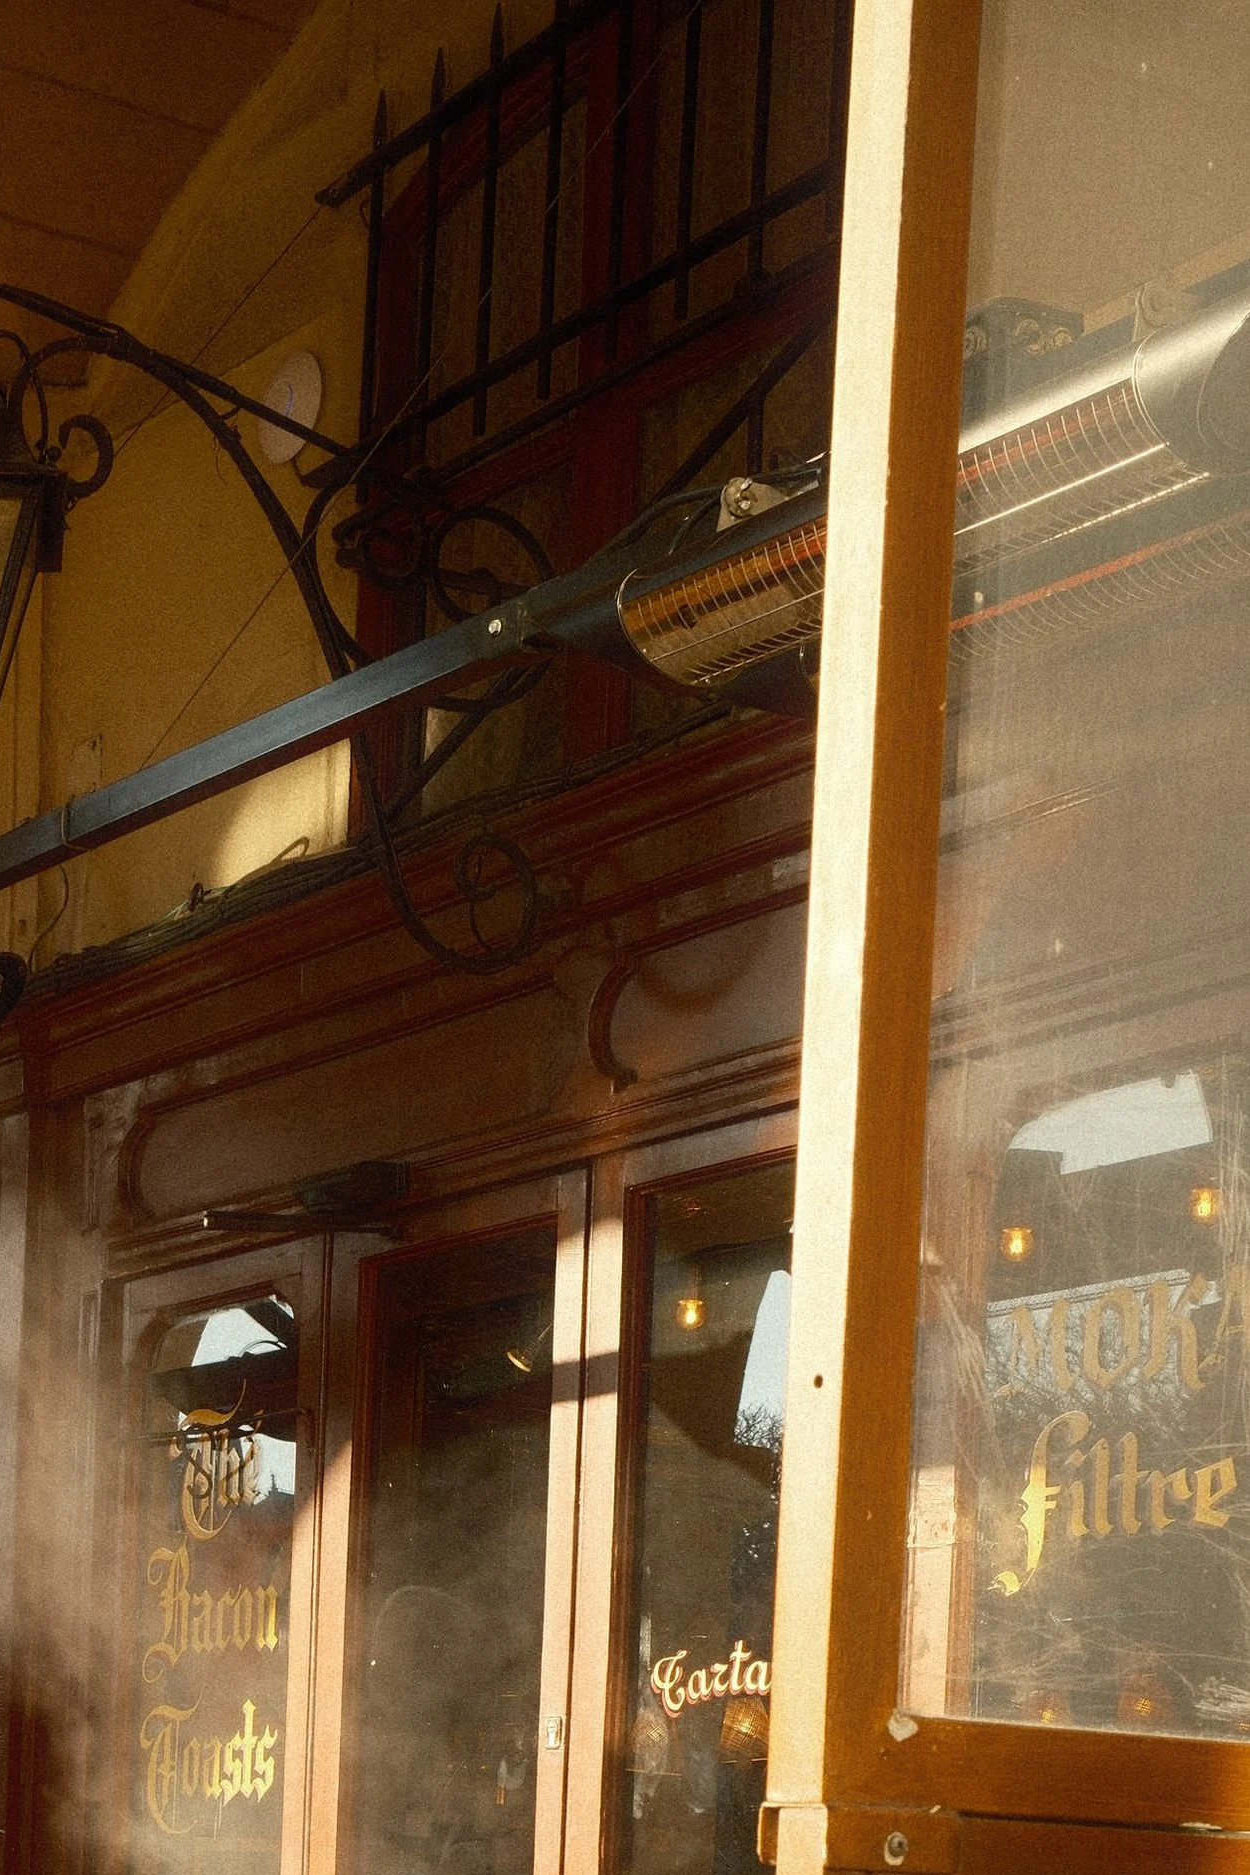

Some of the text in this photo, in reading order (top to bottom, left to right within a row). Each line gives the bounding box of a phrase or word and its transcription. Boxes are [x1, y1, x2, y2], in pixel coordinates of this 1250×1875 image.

[986, 1410, 1238, 1596] filtre
[142, 1537, 279, 1684] Bacon
[140, 1690, 278, 1838] Toasts
